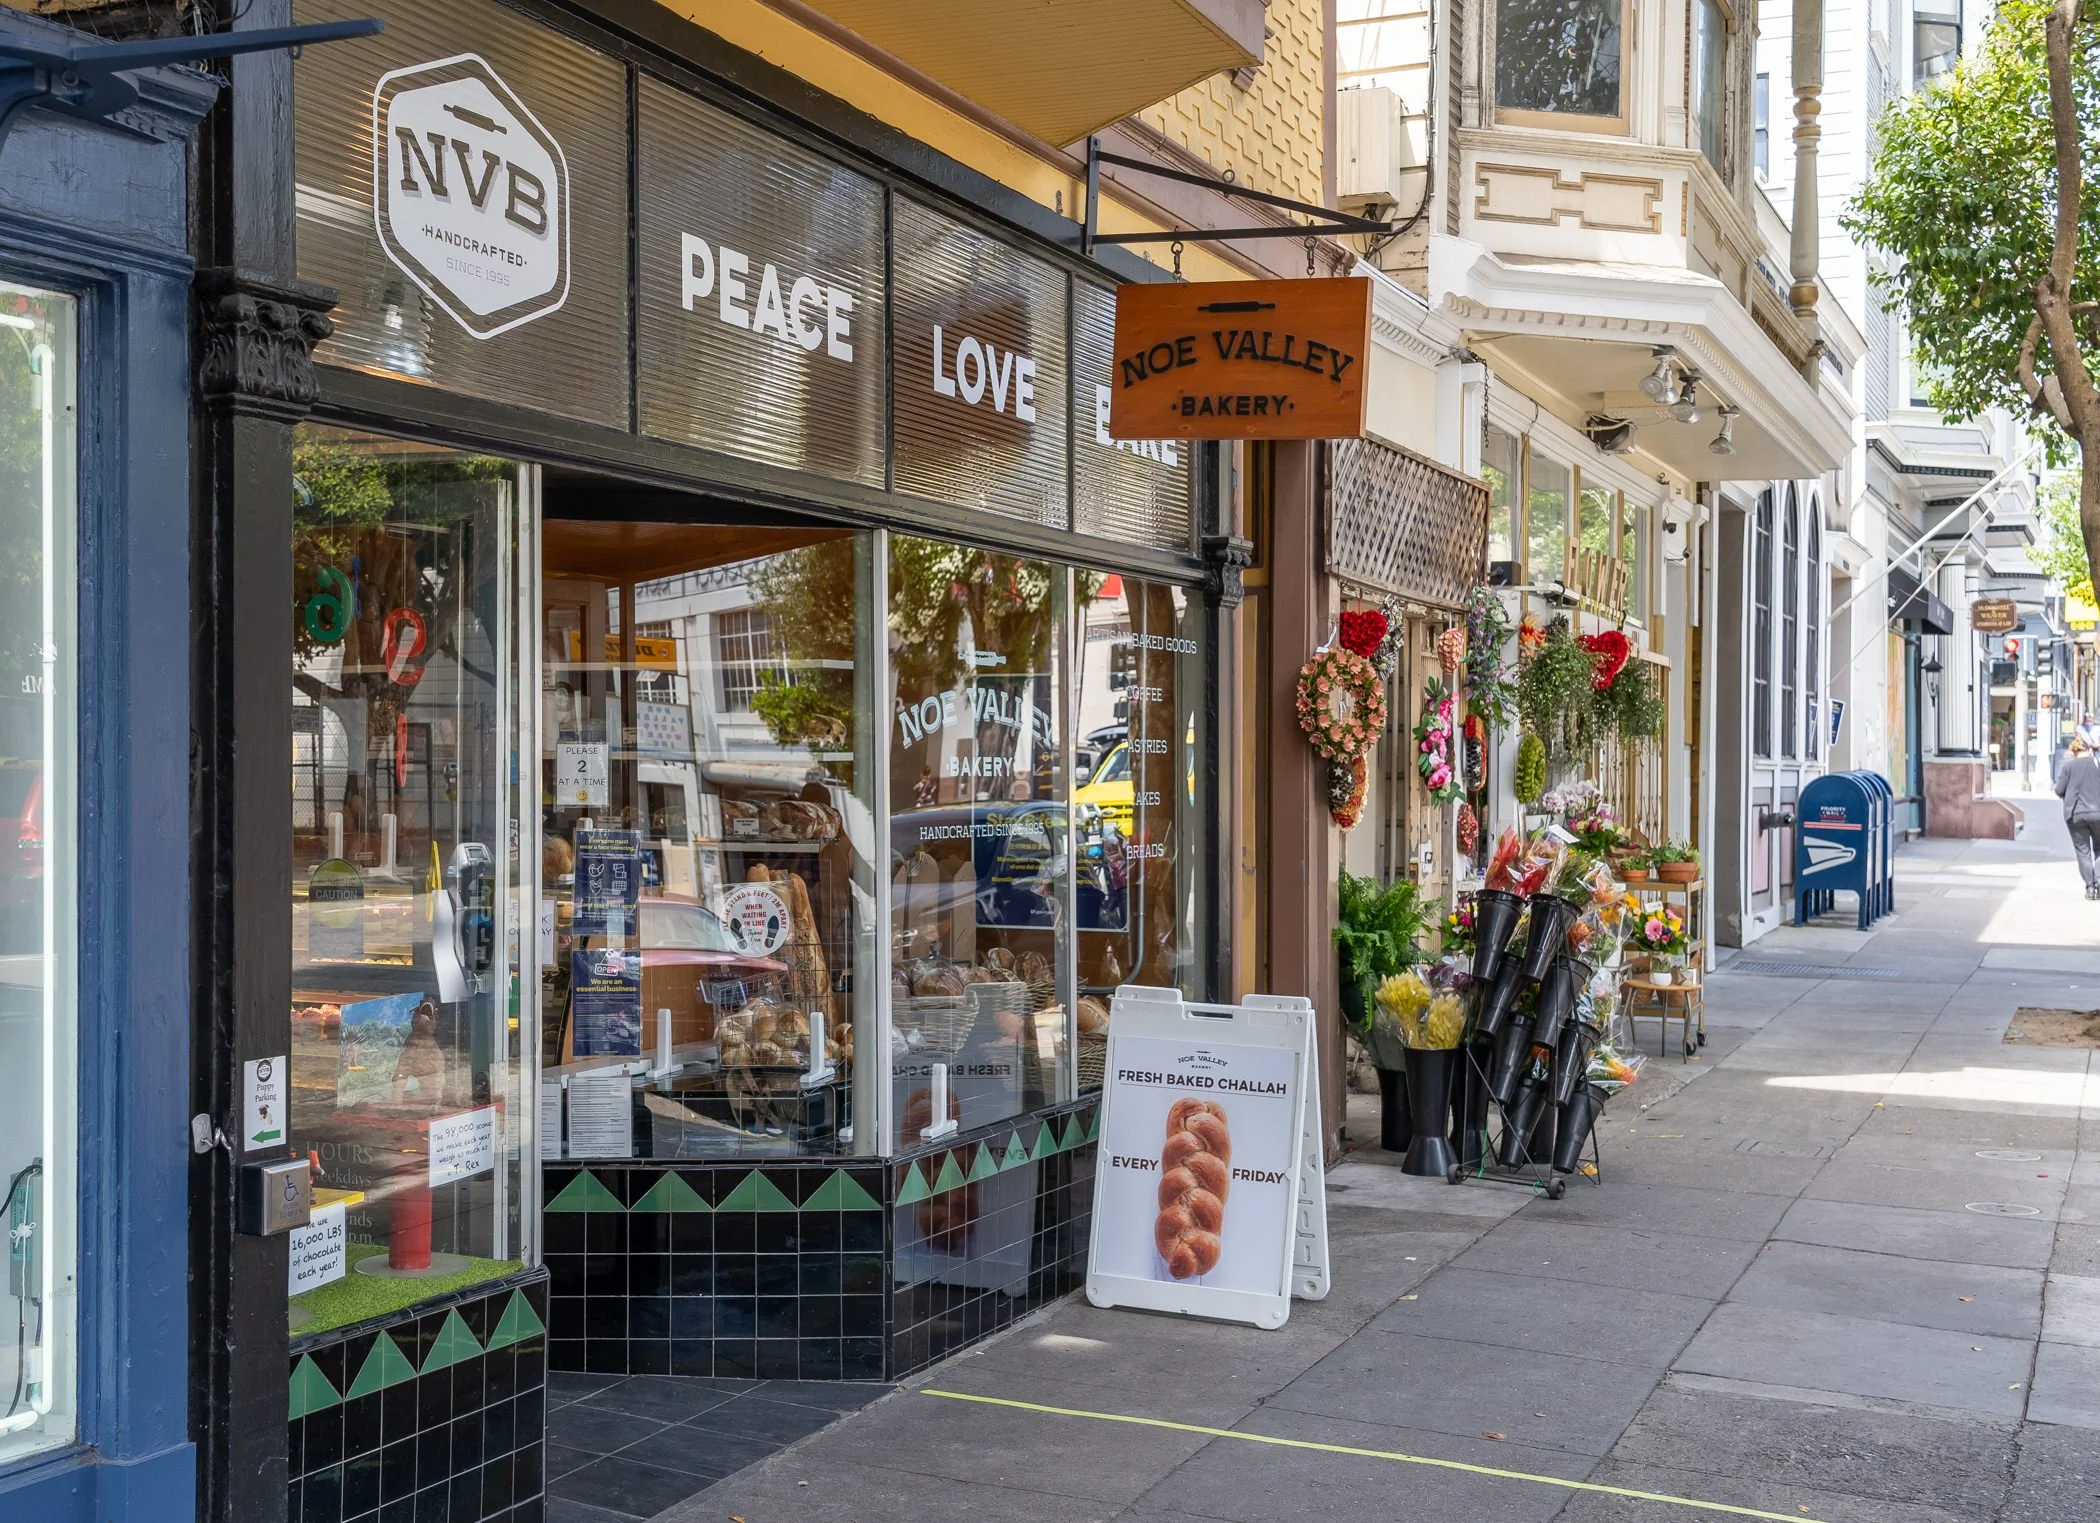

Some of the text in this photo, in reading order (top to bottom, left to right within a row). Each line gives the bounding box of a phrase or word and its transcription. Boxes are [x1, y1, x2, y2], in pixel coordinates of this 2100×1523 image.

[395, 127, 548, 238] NVB
[445, 257, 511, 287] SINCE 1995
[681, 231, 853, 363] PEACE
[1121, 329, 1354, 388] NOE VALLEY
[933, 324, 1036, 423] LOVE
[1086, 629, 1197, 654] ARTISAN BAKED GOODS
[1126, 685, 1163, 701] COFFEE
[899, 690, 958, 749] NOE
[1121, 738, 1168, 753] PASTRIES
[577, 760, 587, 773] 2
[919, 823, 1045, 840] HANDCRAFTED SINCE 1995
[1126, 844, 1164, 860] BREADS
[315, 889, 358, 900] CAUTION
[729, 892, 746, 908] STAND
[753, 890, 769, 899] FEET
[772, 898, 782, 909] 2M
[778, 909, 787, 929] APART
[1178, 1055, 1228, 1067] NOE VALLEY
[256, 1083, 275, 1093] Puppy
[1118, 1069, 1287, 1095] FRESH BAKED CHALLAH
[255, 1092, 277, 1103] Parking
[433, 1133, 444, 1141] The
[445, 1122, 474, 1138] 98,000
[446, 1141, 463, 1150] make
[464, 1136, 477, 1147] each
[478, 1132, 491, 1145] year
[306, 1141, 373, 1164] HOURS
[439, 1144, 488, 1165] weigh as much as
[453, 1162, 462, 1175] T.
[465, 1159, 480, 1171] Rex
[1112, 1155, 1159, 1171] EVERY
[316, 1167, 372, 1187] eekdays
[1232, 1168, 1285, 1184] FRIDAY
[317, 1216, 329, 1227] use
[292, 1224, 342, 1252] 16,000 LBS
[292, 1244, 342, 1267] of chocolate
[297, 1258, 339, 1280] each year!
